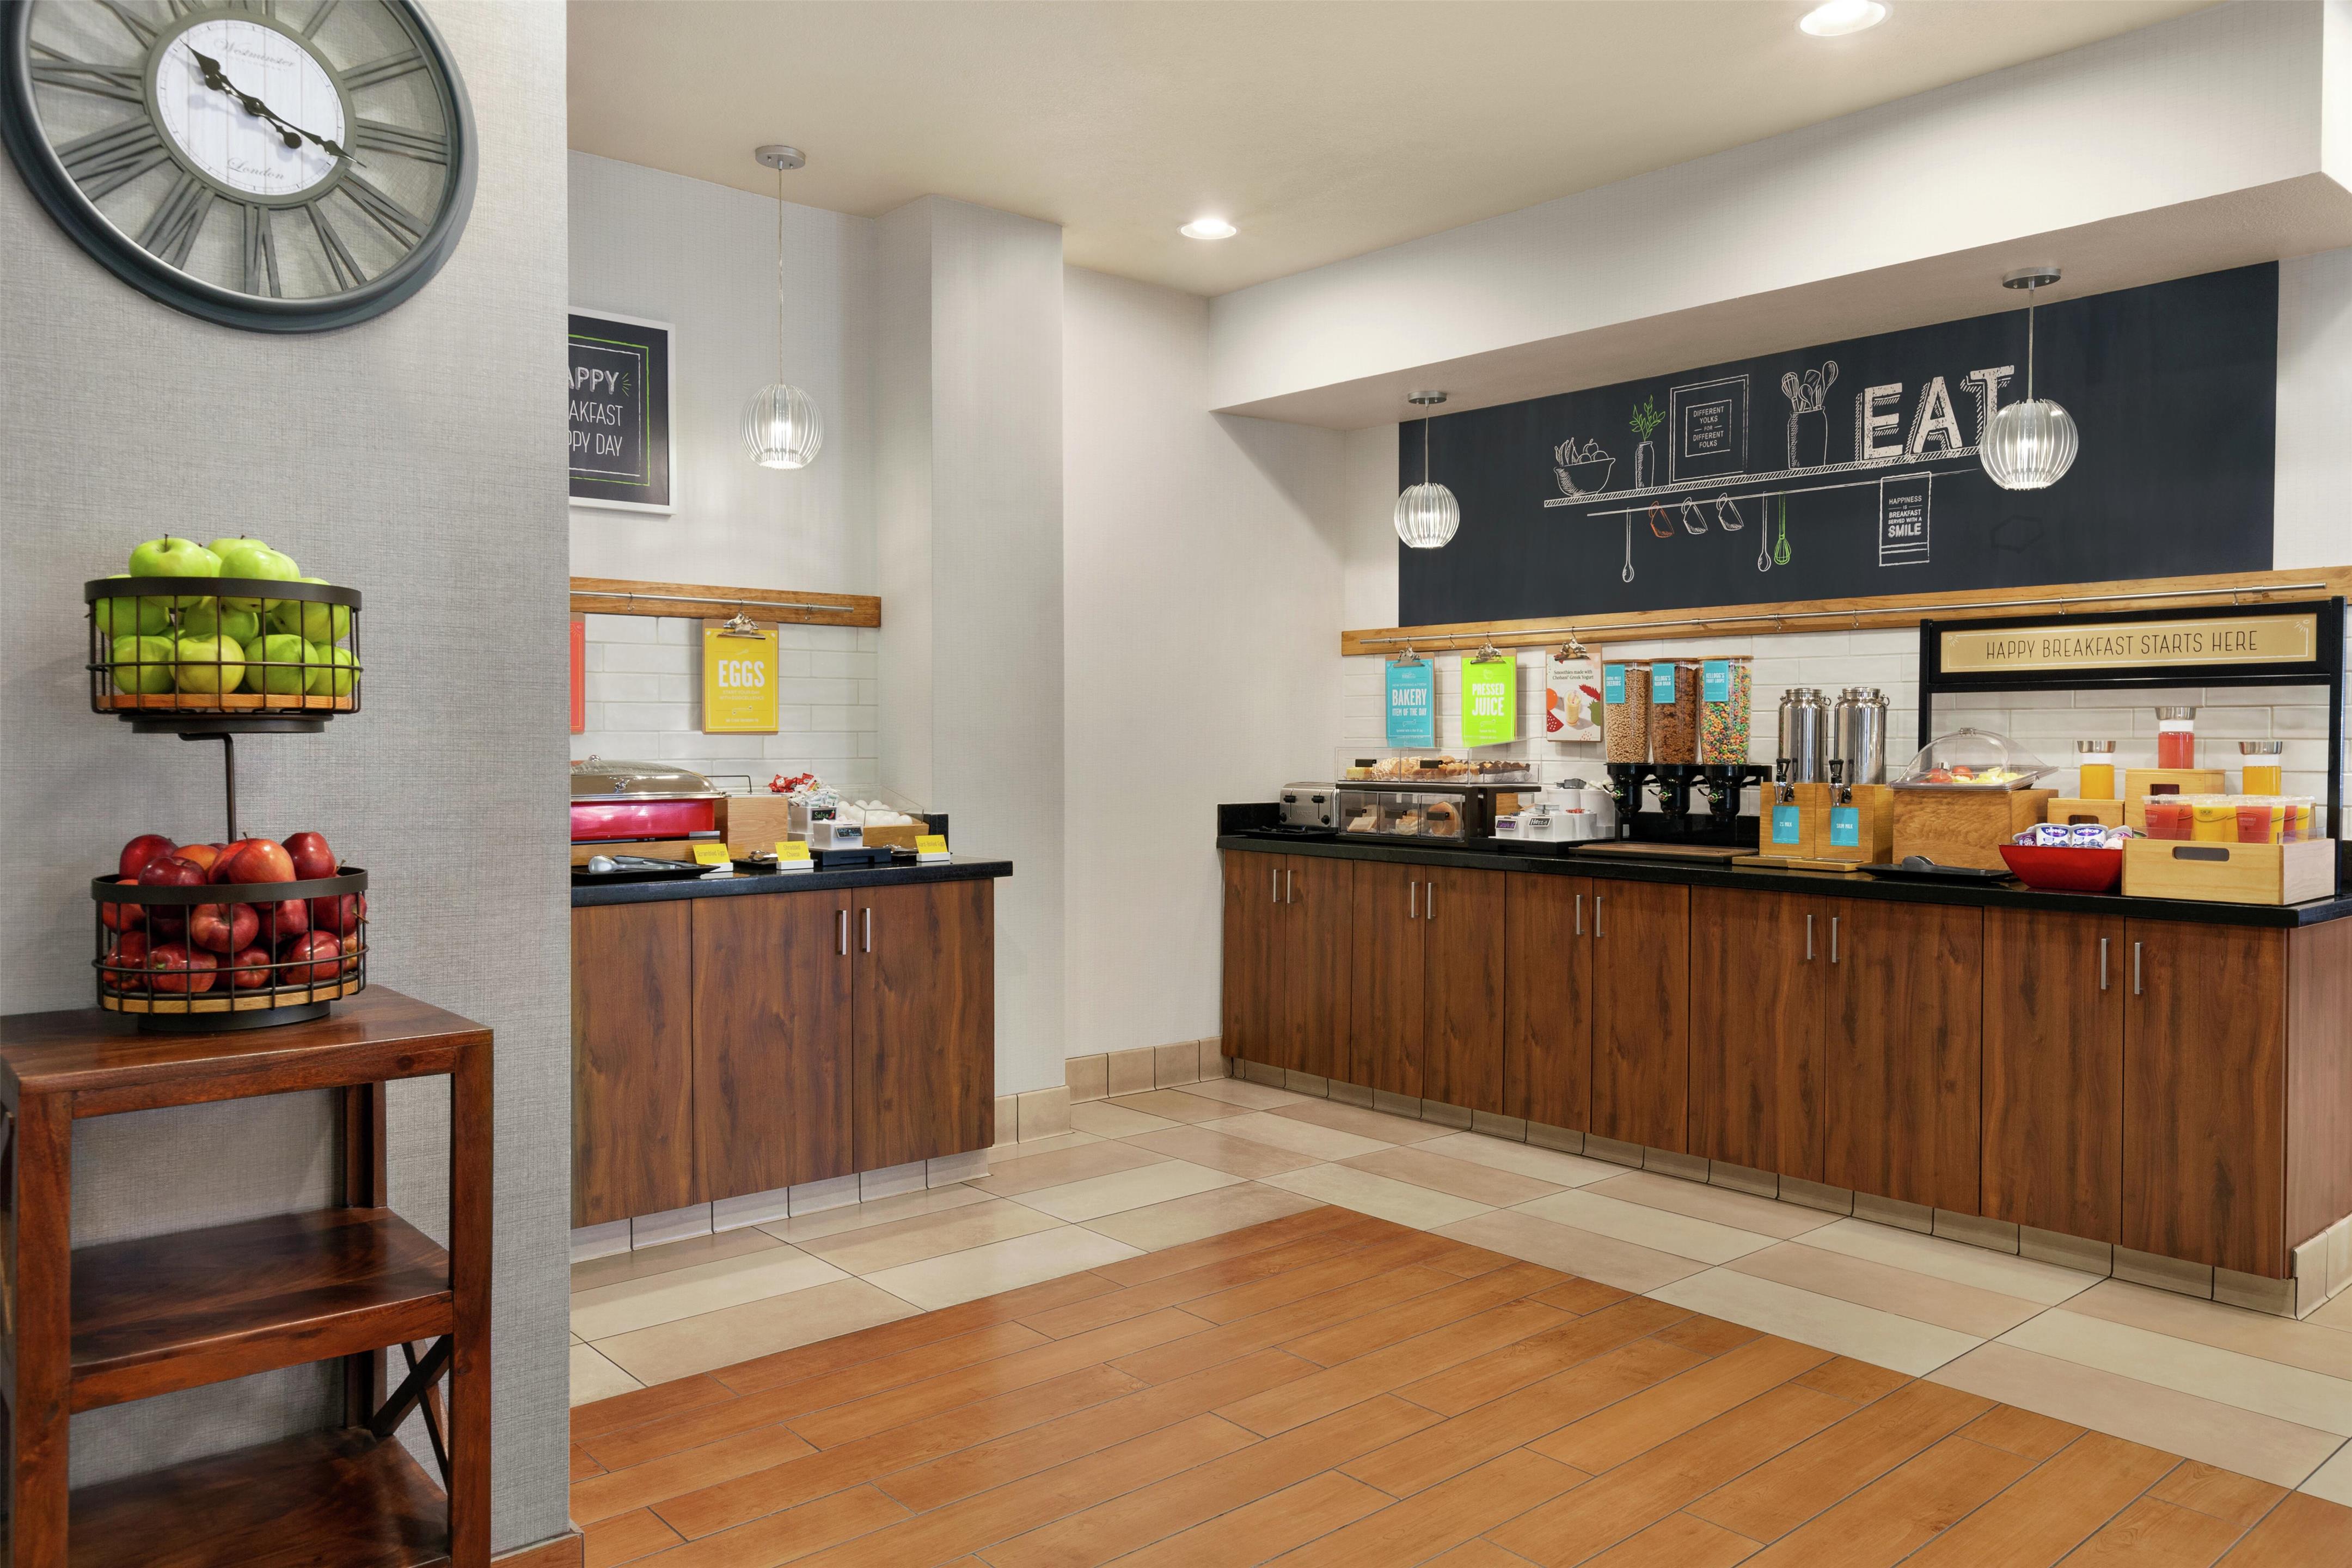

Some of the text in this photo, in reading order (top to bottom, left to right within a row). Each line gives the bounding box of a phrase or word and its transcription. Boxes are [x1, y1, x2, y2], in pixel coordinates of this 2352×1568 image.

[213, 38, 295, 66] Westminster
[226, 157, 284, 180] London
[1693, 406, 1724, 418] DIFFERENT
[1857, 364, 2015, 461] EAT
[1700, 415, 1718, 424] YOLKS
[1693, 430, 1724, 442] DIFFERENT
[596, 433, 622, 456] DAY
[1699, 439, 1718, 449] FOLKS
[1889, 495, 1922, 505] HAPPINESS
[1889, 509, 1921, 518] BREAKFAST
[1888, 523, 1921, 537] SMILE
[1987, 630, 2257, 659] HAPPY BREAKFAST STARTS HERE
[718, 659, 765, 687] EGGS
[1472, 683, 1505, 696] PRESSED
[1392, 688, 1426, 706] BAKERY
[1392, 708, 1402, 716] ITEM
[1403, 708, 1408, 716] OF
[1472, 696, 1505, 716] JUICE
